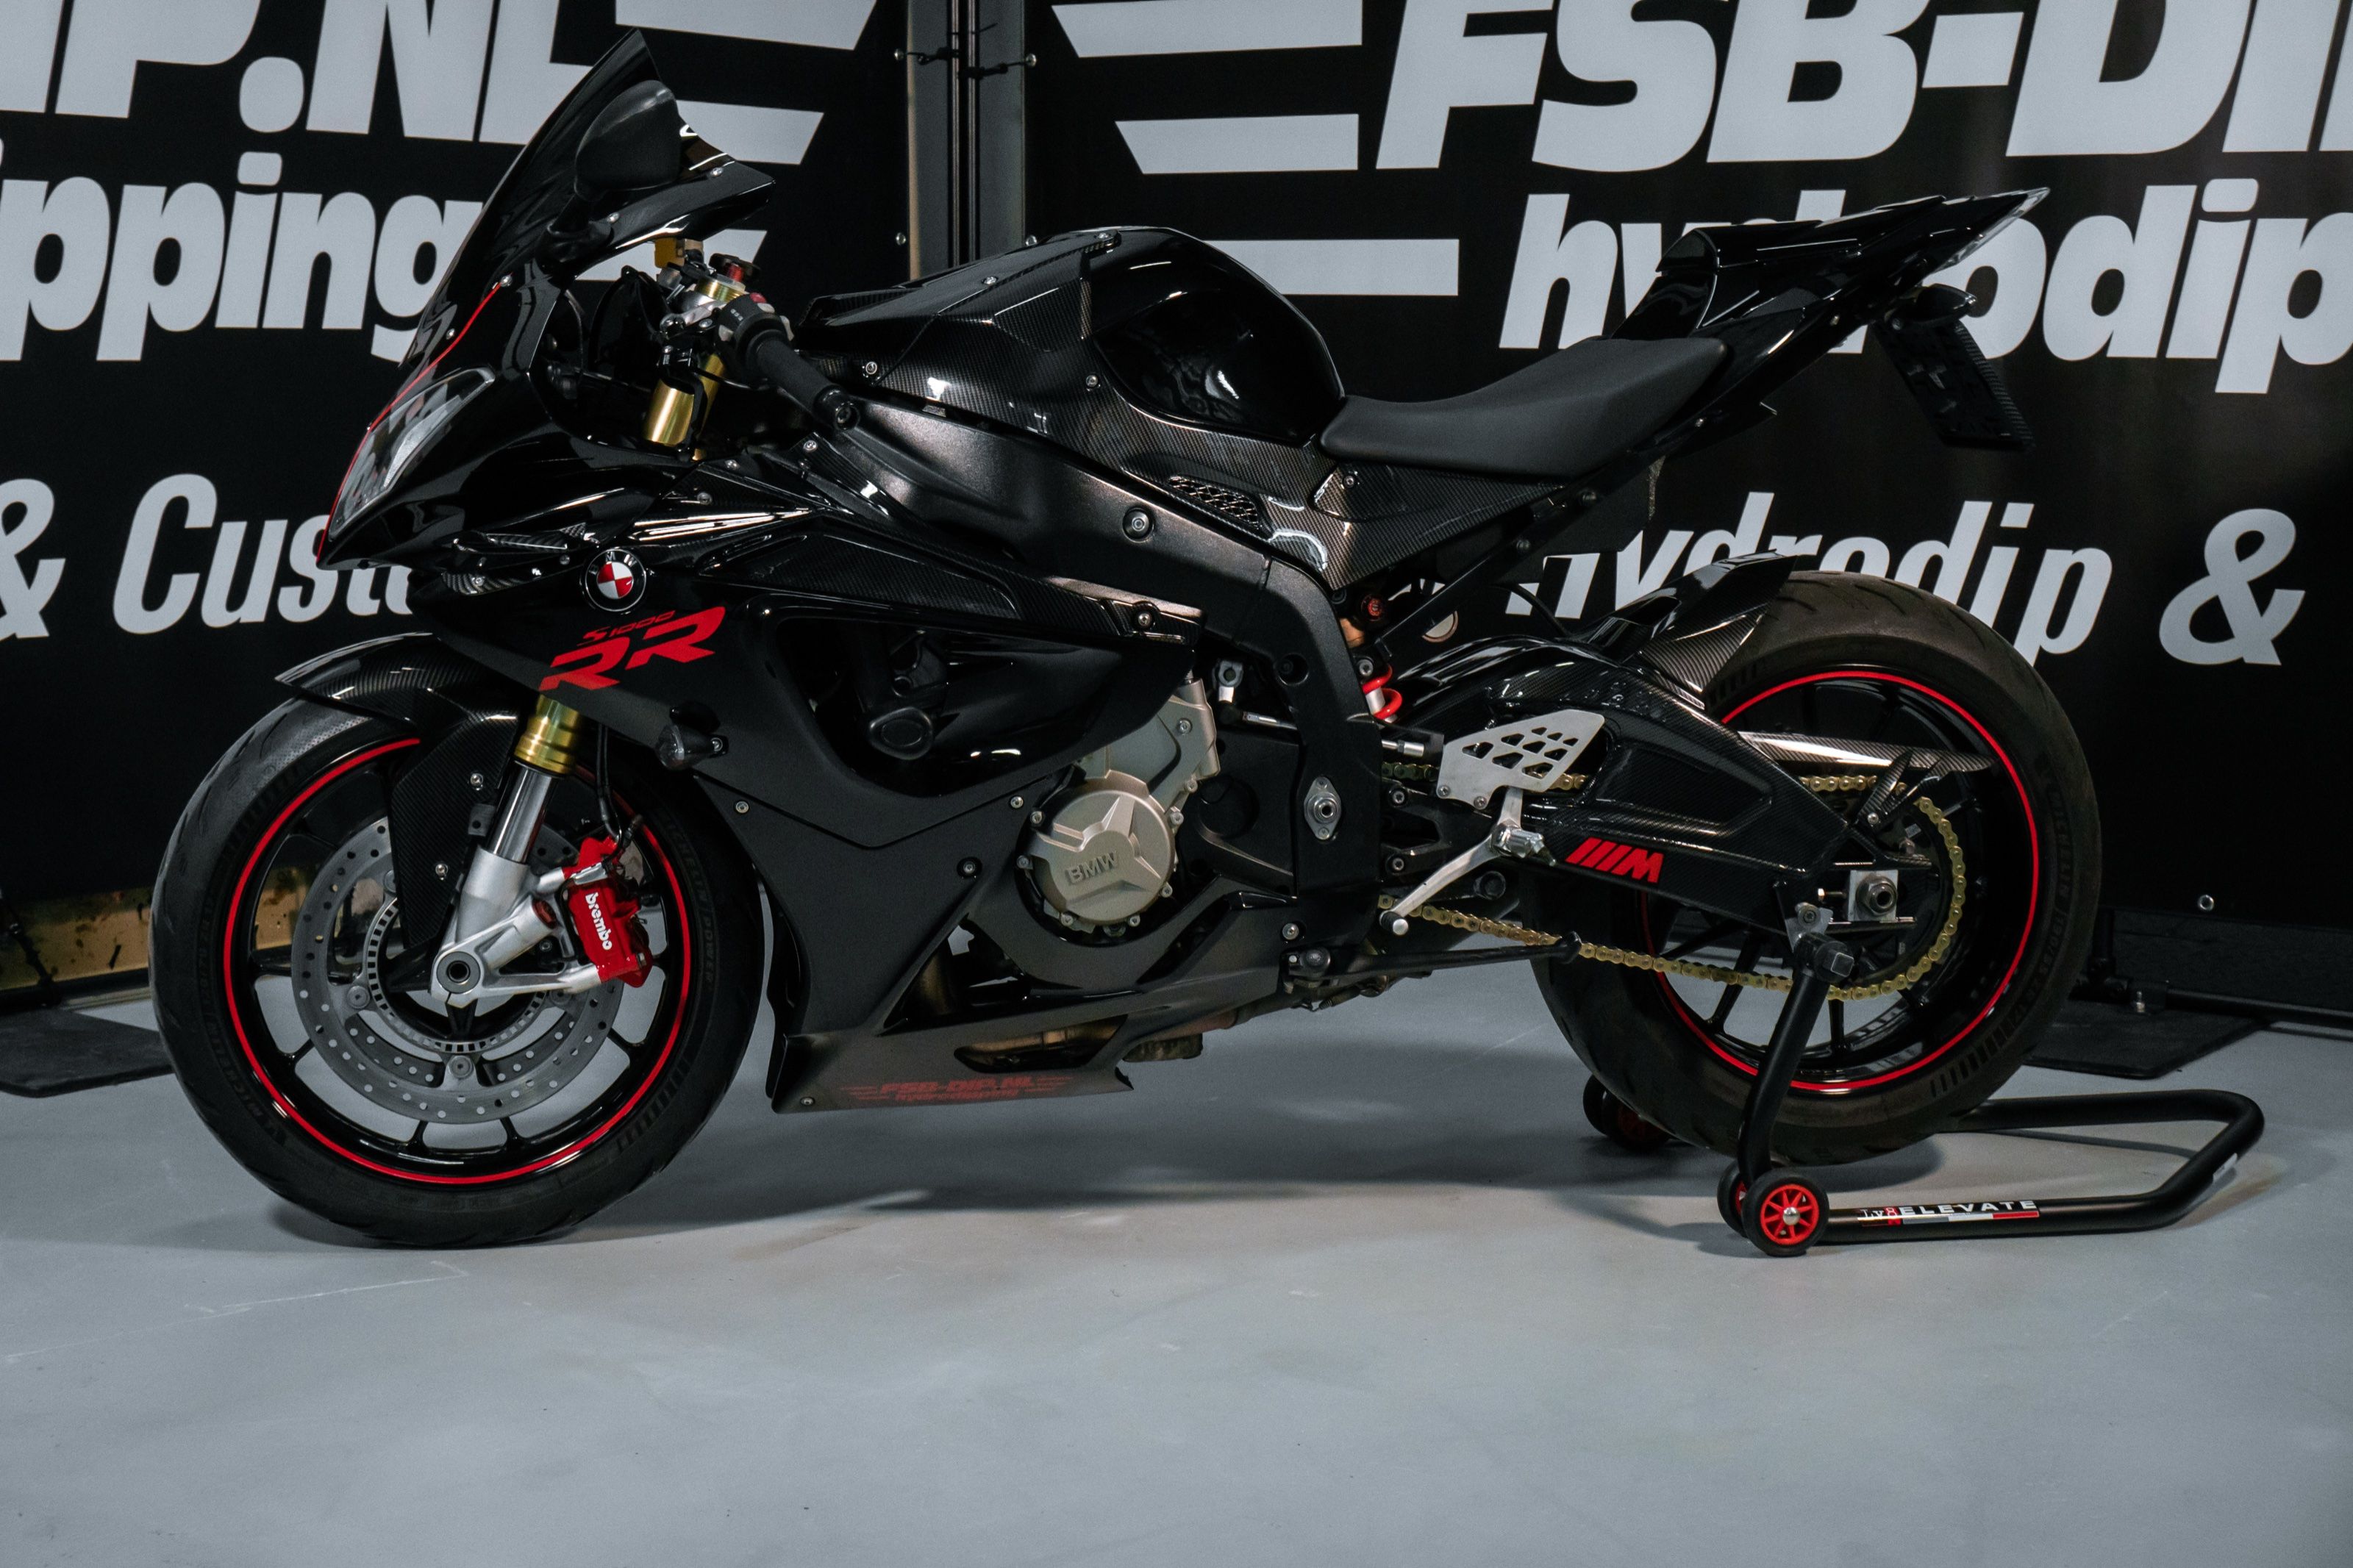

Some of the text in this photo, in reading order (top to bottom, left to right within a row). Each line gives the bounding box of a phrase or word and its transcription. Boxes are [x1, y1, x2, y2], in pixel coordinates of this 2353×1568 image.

[1375, 0, 2353, 173] FSB-DI
[0, 138, 483, 363] pping
[1498, 179, 2353, 393] hodip
[2159, 509, 2306, 666] &
[538, 606, 726, 691] RR
[585, 892, 613, 951] brembo
[1065, 851, 1118, 885] BMW
[1899, 1200, 2037, 1216] ELEVATE
